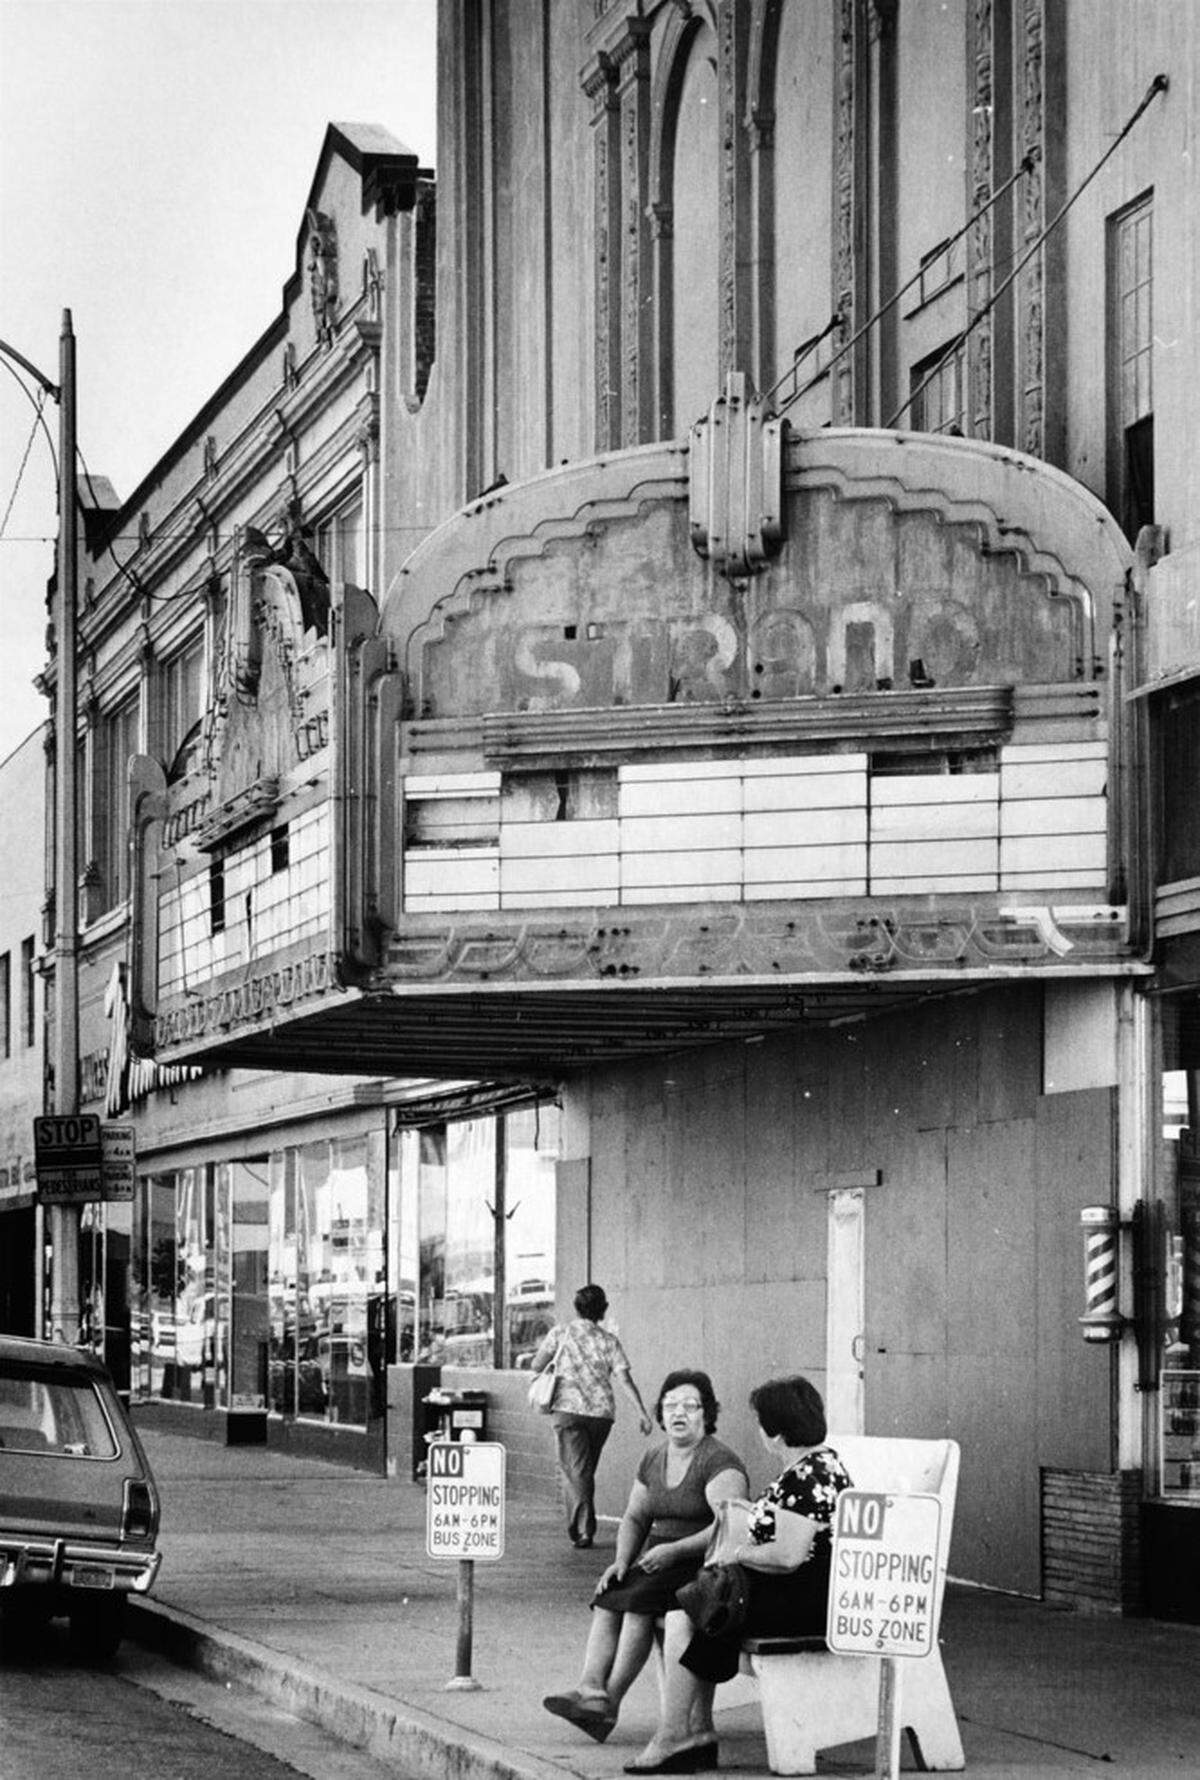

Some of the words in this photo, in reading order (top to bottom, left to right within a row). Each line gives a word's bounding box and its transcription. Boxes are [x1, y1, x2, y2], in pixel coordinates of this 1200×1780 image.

[40, 1119, 94, 1144] STOP
[433, 1447, 460, 1474] NO
[433, 1485, 500, 1506] STOPPING
[842, 1498, 880, 1535] NO
[434, 1531, 460, 1546] BUS
[464, 1532, 497, 1548] ZONE
[839, 1549, 933, 1584] STOPPING
[837, 1615, 873, 1637] BUS
[878, 1618, 926, 1642] ZONE
